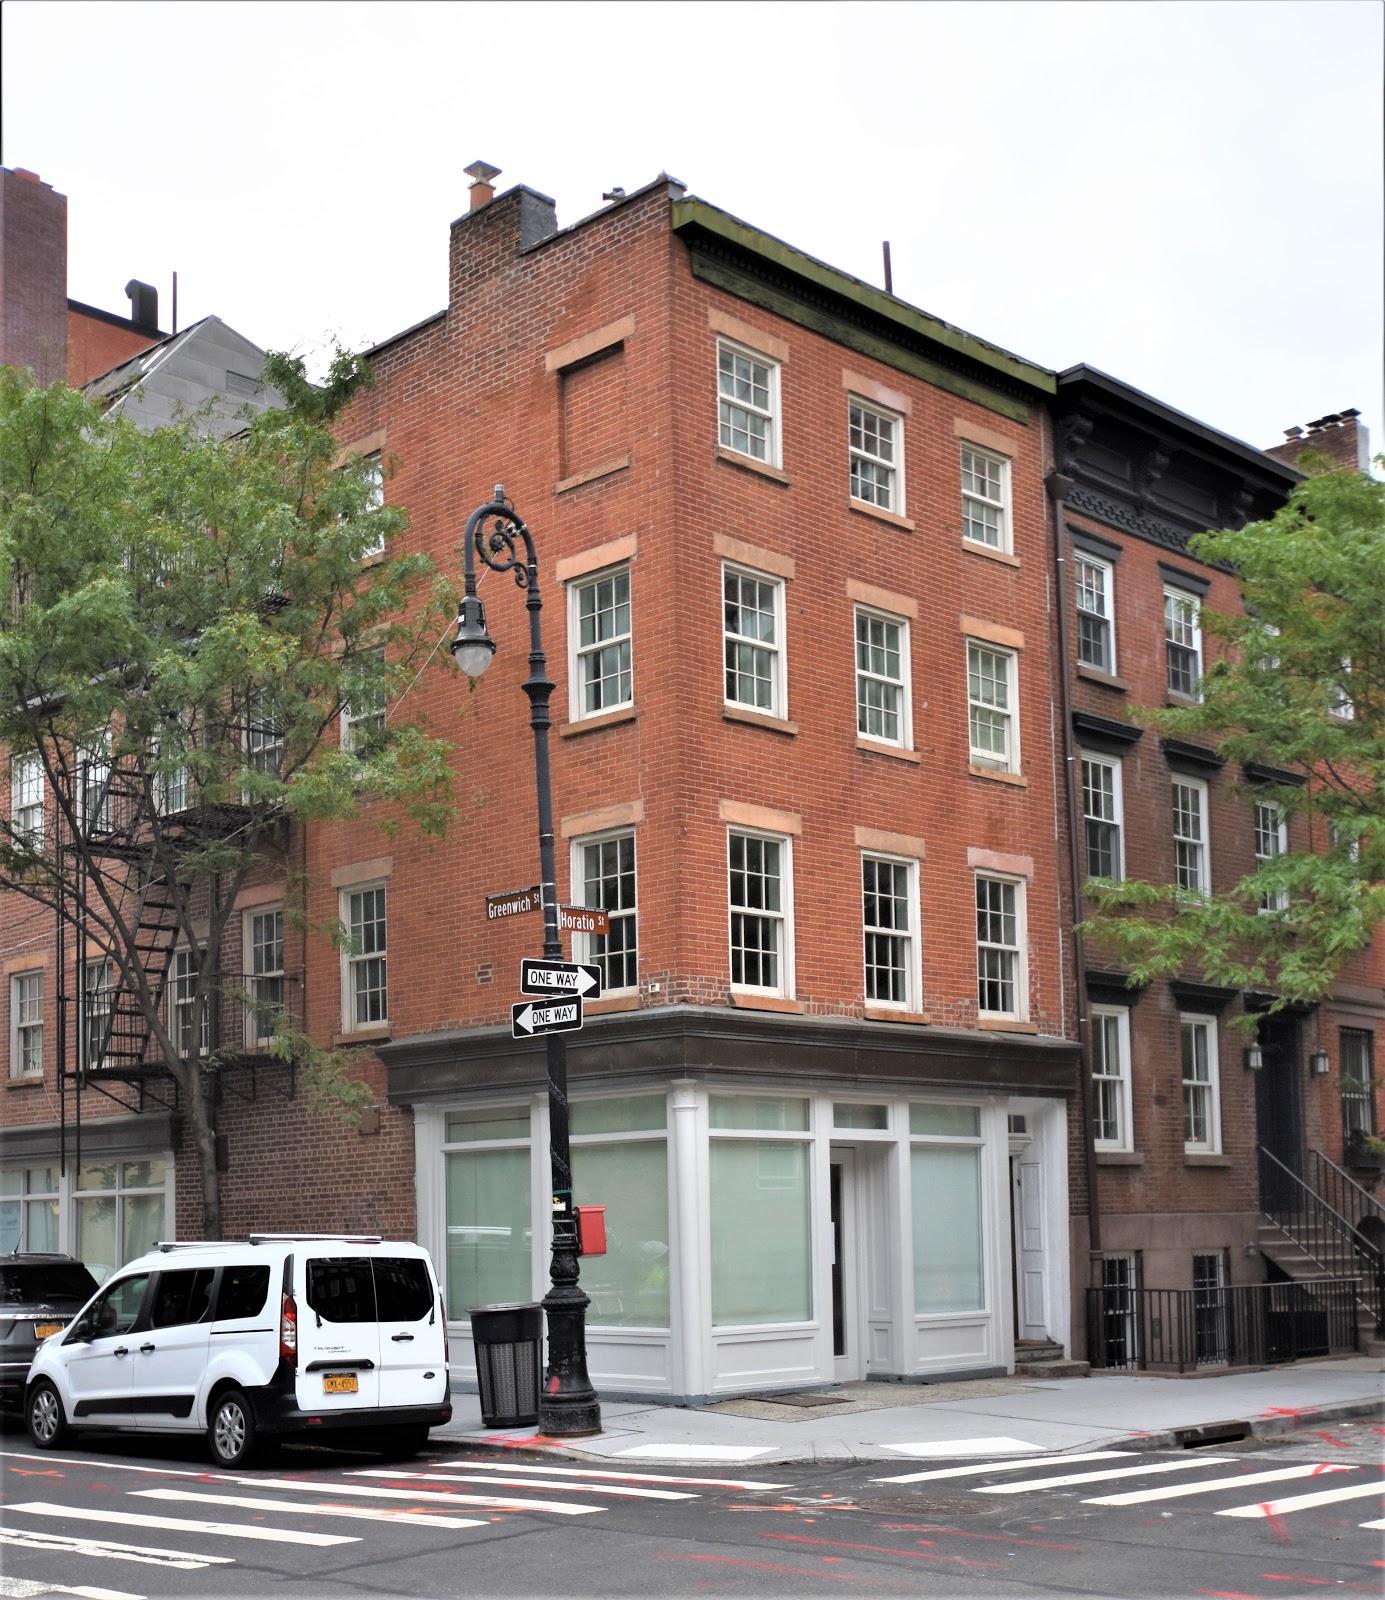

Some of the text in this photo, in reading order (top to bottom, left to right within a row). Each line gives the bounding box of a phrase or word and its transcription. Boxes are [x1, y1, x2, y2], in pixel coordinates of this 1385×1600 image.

[488, 896, 531, 919] Greenwich
[533, 893, 540, 904] St
[561, 912, 605, 931] Horatio St
[530, 970, 578, 987] ONE WAY
[532, 1006, 574, 1025] ONE WAY
